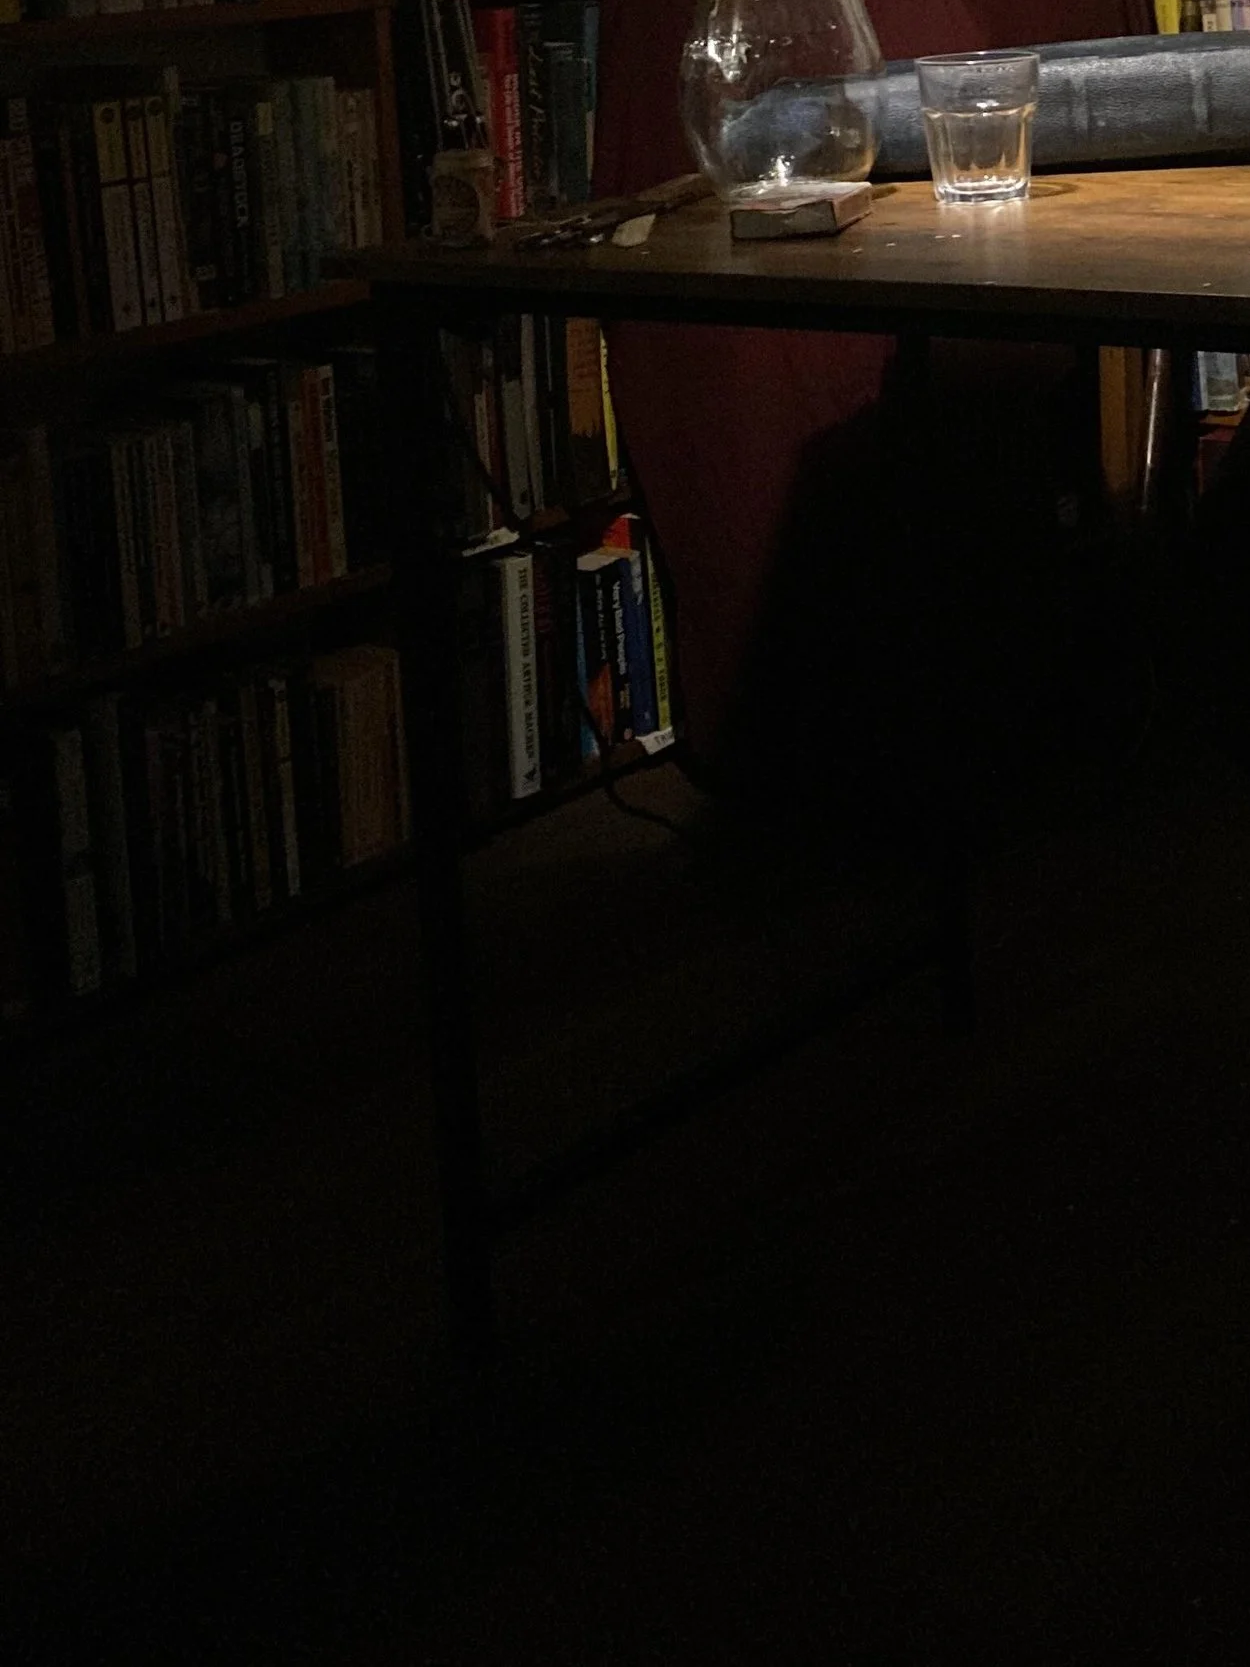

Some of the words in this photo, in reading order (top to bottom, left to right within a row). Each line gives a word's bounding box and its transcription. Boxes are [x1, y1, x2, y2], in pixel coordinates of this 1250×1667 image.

[517, 567, 528, 589] THE
[612, 580, 622, 609] Very
[519, 593, 531, 658] COLLECTED
[614, 609, 624, 633] Bad
[615, 633, 627, 676] People
[521, 662, 533, 705] ARTHUR
[523, 712, 535, 760] MACHEN
